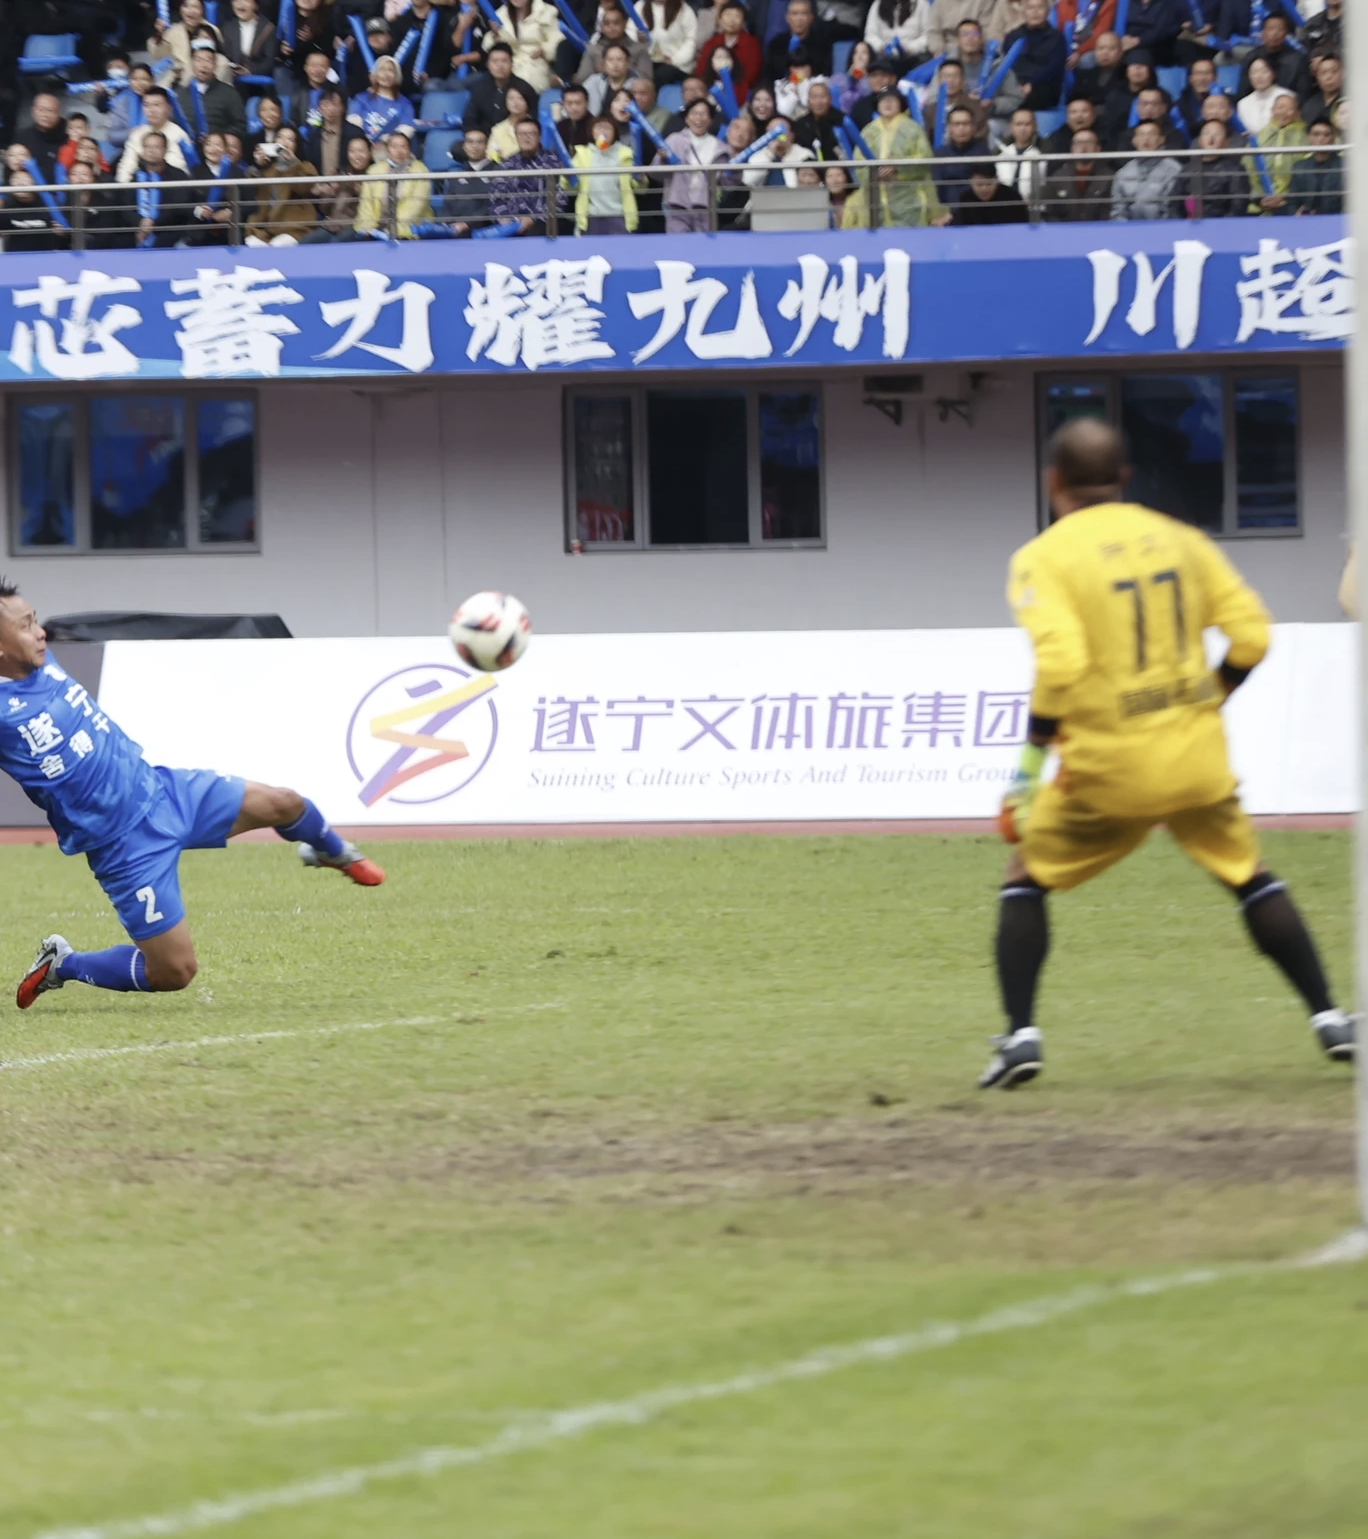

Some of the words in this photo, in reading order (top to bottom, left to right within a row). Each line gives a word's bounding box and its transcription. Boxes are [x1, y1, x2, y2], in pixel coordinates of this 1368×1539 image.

[1084, 236, 1354, 350] 川超
[1112, 567, 1188, 674] 77
[17, 683, 94, 757] 遂宁
[529, 690, 1030, 752] 遂宁文体旅集团
[528, 768, 616, 791] Suining
[626, 766, 711, 788] Culture
[719, 764, 792, 789] Sports
[799, 764, 848, 784] And
[856, 763, 948, 785] Tourism
[957, 764, 1018, 784] Grou
[135, 886, 164, 924] 2
